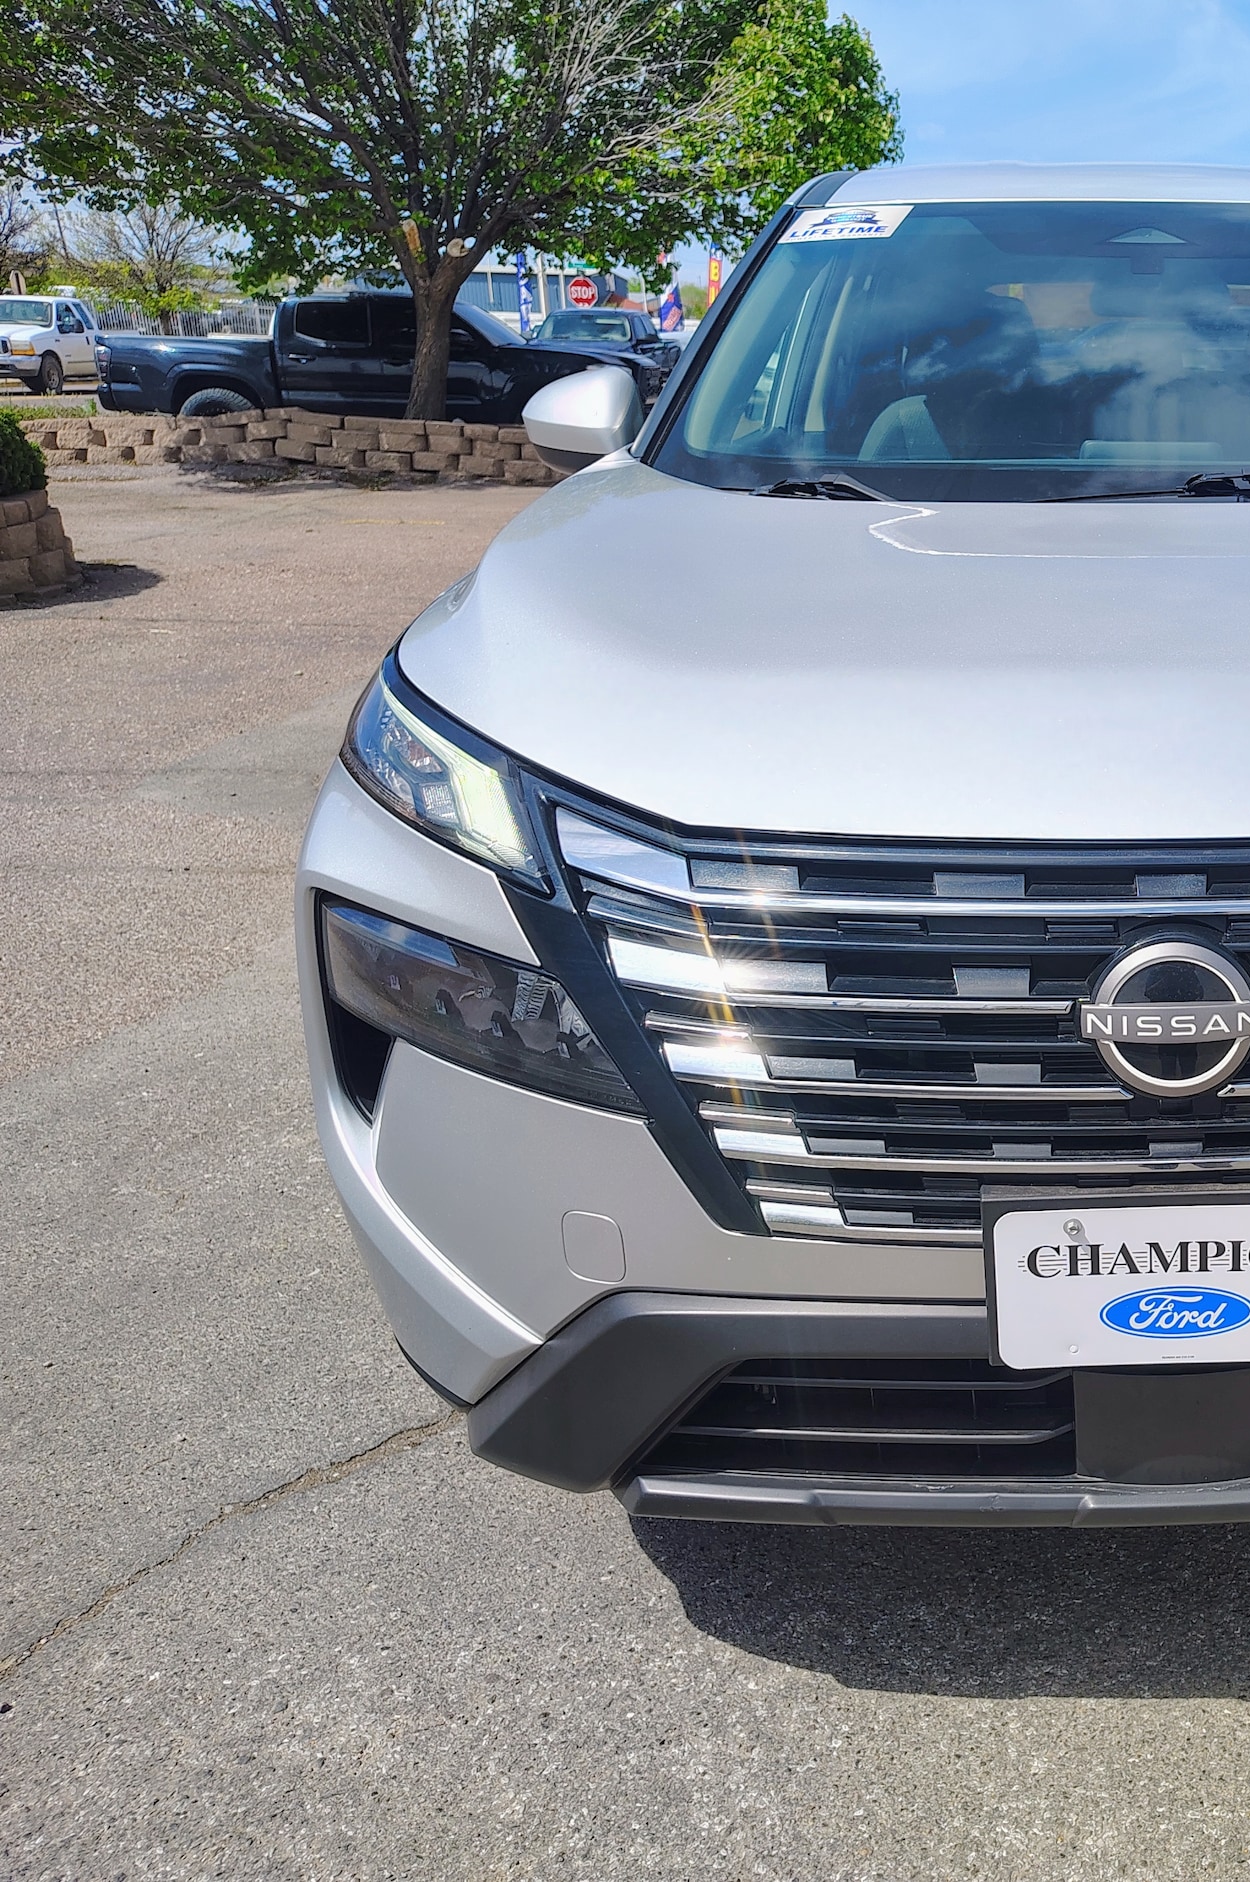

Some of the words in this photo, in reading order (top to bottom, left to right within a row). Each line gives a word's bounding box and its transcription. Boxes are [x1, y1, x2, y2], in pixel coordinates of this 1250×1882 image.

[789, 226, 888, 238] LIFETIME
[570, 286, 595, 299] STOP
[1129, 1293, 1228, 1330] Ford
